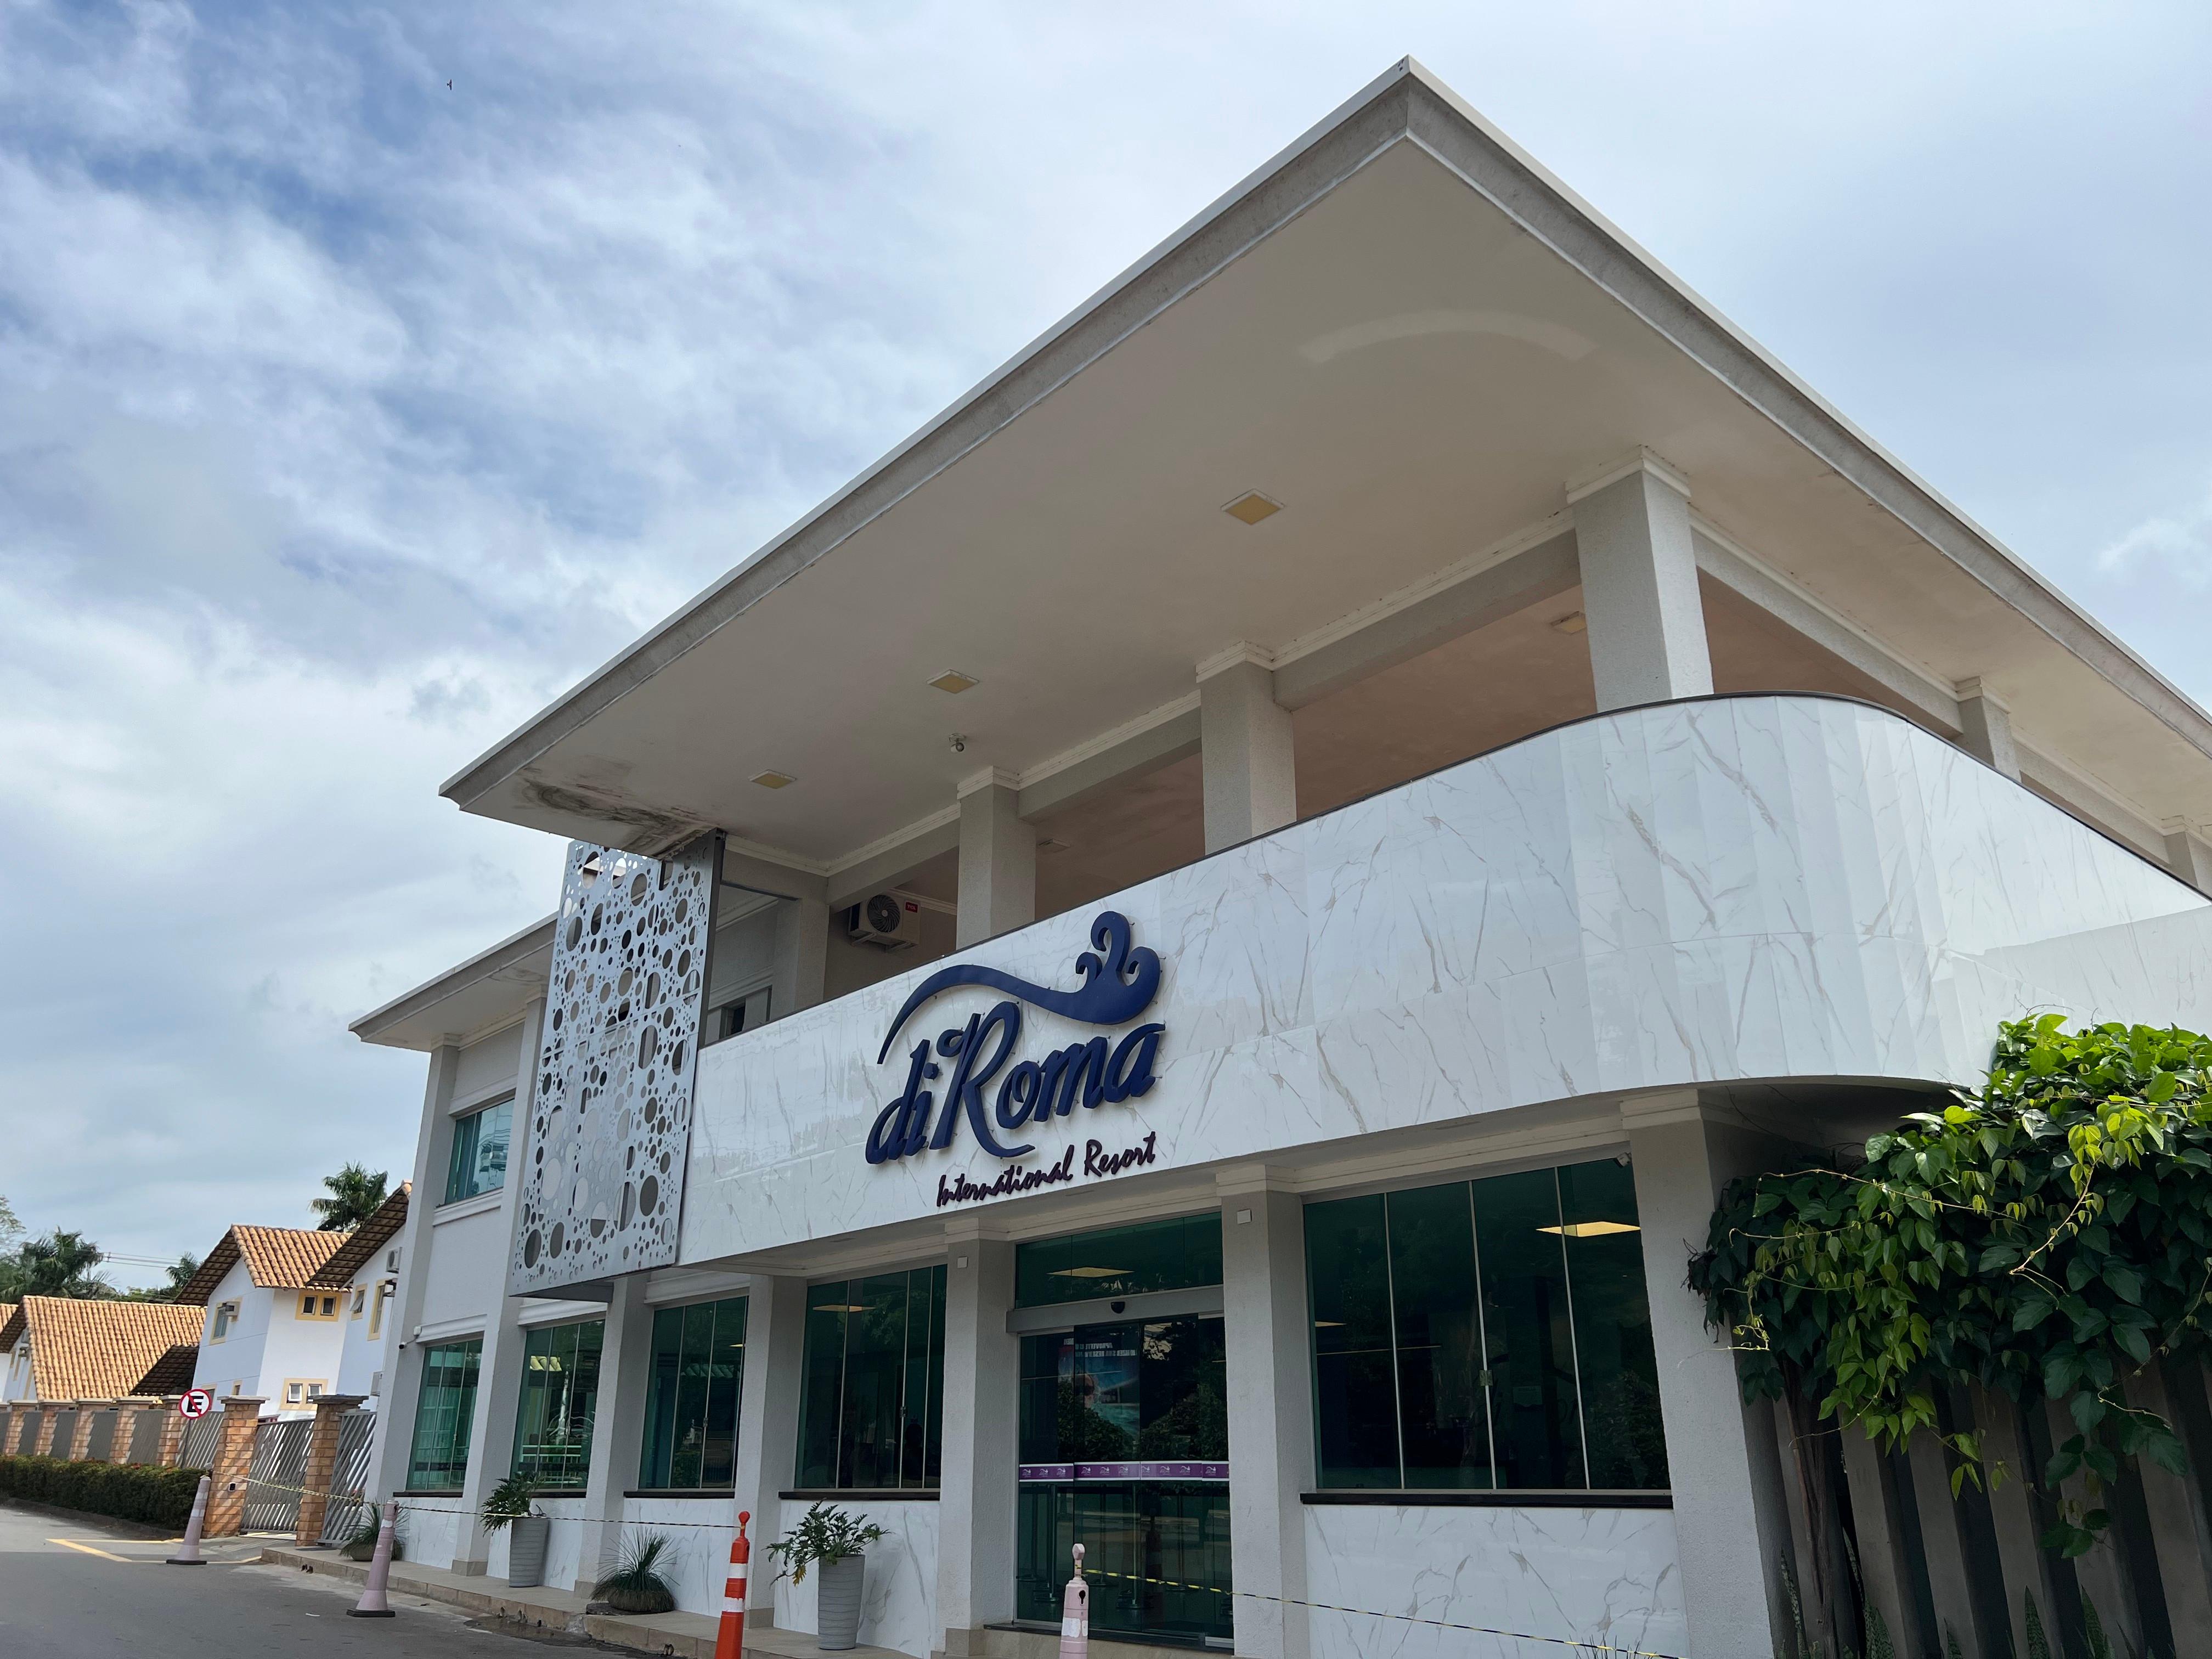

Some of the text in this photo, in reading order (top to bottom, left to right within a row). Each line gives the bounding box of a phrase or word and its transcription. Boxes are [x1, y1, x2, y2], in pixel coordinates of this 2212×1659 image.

[936, 1131, 1156, 1207] International Resort
[187, 1395, 204, 1413] E
